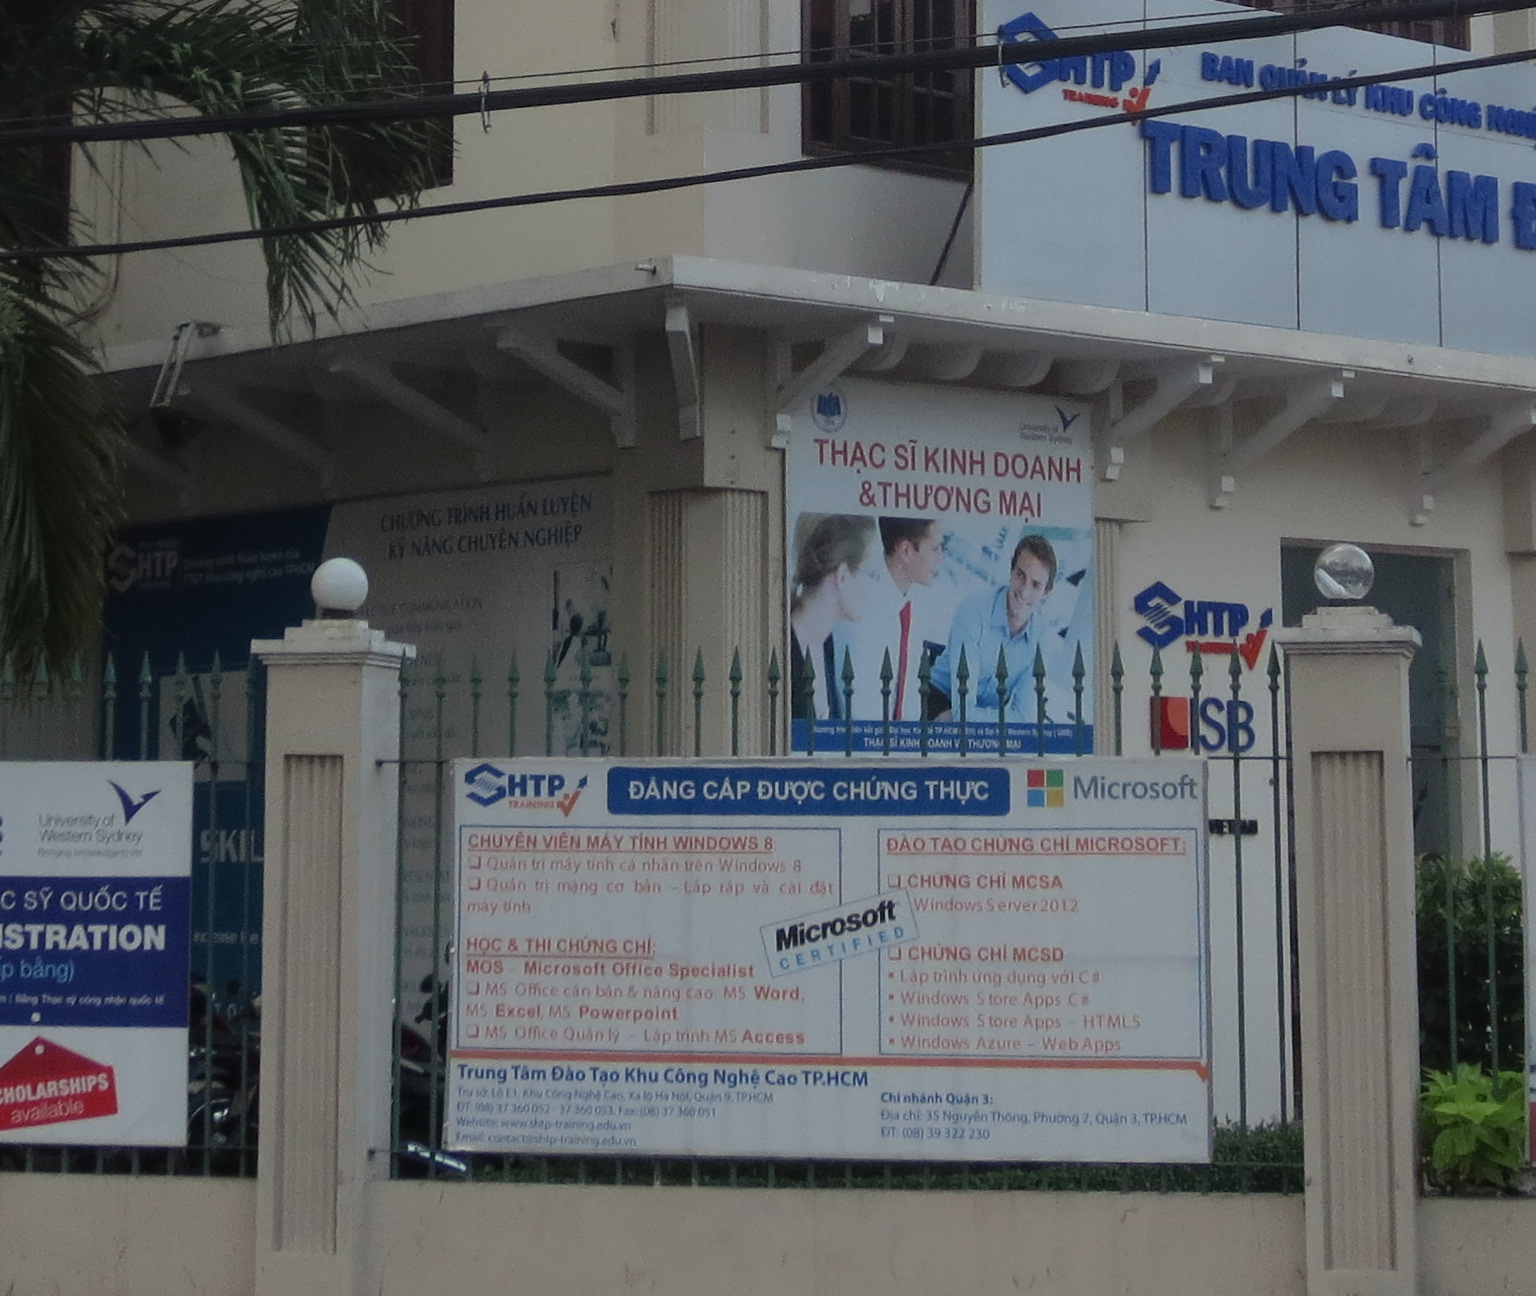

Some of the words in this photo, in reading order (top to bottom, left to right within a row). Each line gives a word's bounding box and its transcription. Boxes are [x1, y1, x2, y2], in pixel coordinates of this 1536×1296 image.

[1063, 89, 1119, 108] TRAINING
[1202, 51, 1253, 87] BAN
[1365, 83, 1414, 116] KHU
[1419, 88, 1482, 129] CÔNG
[1144, 118, 1357, 224] TRUNG
[1370, 141, 1499, 243] TÂM
[814, 438, 886, 474] THẠC
[894, 439, 918, 471] SĨ
[924, 446, 985, 476] KINH
[994, 452, 1082, 483] DOANH
[999, 491, 1042, 523] MẠI
[757, 779, 825, 805] ĐƯỢC
[833, 775, 917, 800] CHỨNG
[925, 780, 989, 805] THỰC
[1072, 775, 1198, 801] Microsoft
[38, 814, 100, 828] University
[40, 830, 91, 842] Western
[96, 830, 143, 845] Sydney
[468, 832, 537, 849] CHUYÊN
[543, 832, 581, 849] VIÊN
[587, 833, 624, 850] MÁY
[630, 833, 667, 851] TÍNH
[673, 836, 759, 851] WINDOWS
[886, 834, 926, 852] ĐÀO
[1012, 874, 1062, 889] MCSA
[60, 885, 128, 912] QUỐC
[135, 885, 163, 911] TẾ
[775, 898, 897, 952] Microsoft
[466, 937, 502, 955] HỌC
[524, 938, 551, 952] THI
[778, 924, 906, 971] CERTIFIED
[1013, 946, 1065, 963] MCSD
[466, 960, 503, 974] MOS
[524, 961, 606, 976] Microsoft
[612, 962, 663, 976] Office
[669, 963, 755, 980] Specialist
[579, 1006, 679, 1021] Powerpoint
[742, 1031, 806, 1044] Access
[458, 1064, 507, 1084] Trung
[512, 1064, 546, 1081] Tâm
[552, 1065, 586, 1082] Đào
[590, 1066, 620, 1087] Tạo
[625, 1067, 658, 1083] Khu
[664, 1068, 708, 1088] Công
[714, 1069, 760, 1089] Nghệ
[765, 1070, 797, 1086] Cao
[802, 1071, 868, 1087] TP.HCM
[10, 1098, 85, 1124] available
